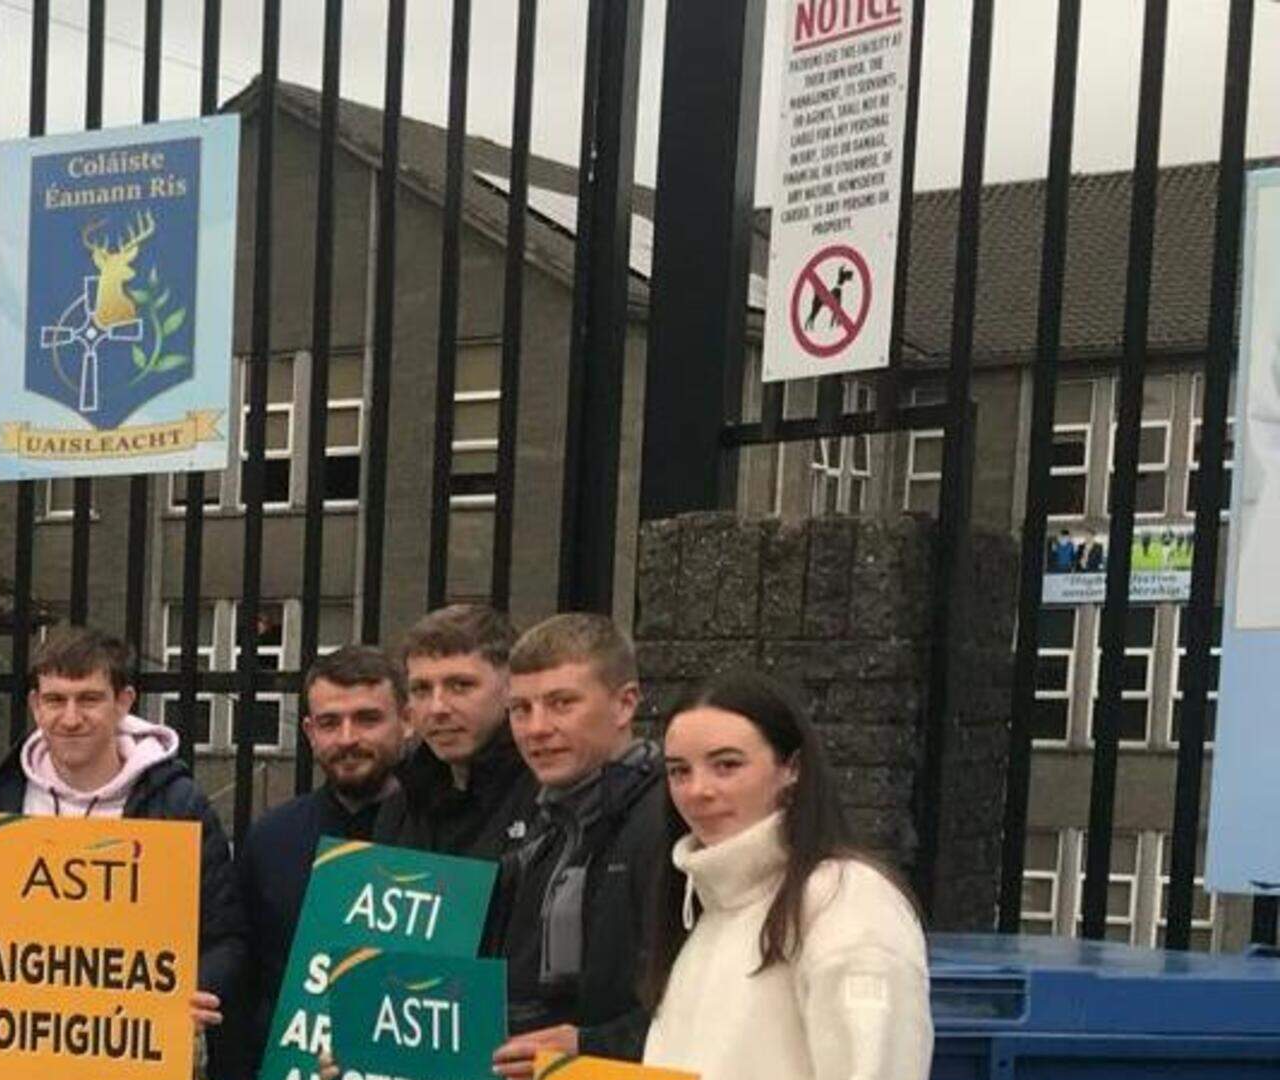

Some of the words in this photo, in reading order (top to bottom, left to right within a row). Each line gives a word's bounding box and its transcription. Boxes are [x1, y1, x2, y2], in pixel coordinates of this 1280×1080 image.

[67, 151, 165, 178] Coláiste
[45, 182, 141, 209] Éamann
[150, 173, 187, 199] Rís
[27, 429, 184, 454] UAISLEACHT
[21, 856, 141, 903] ASTI
[346, 883, 442, 940] ASTI
[373, 995, 460, 1052] ASTI
